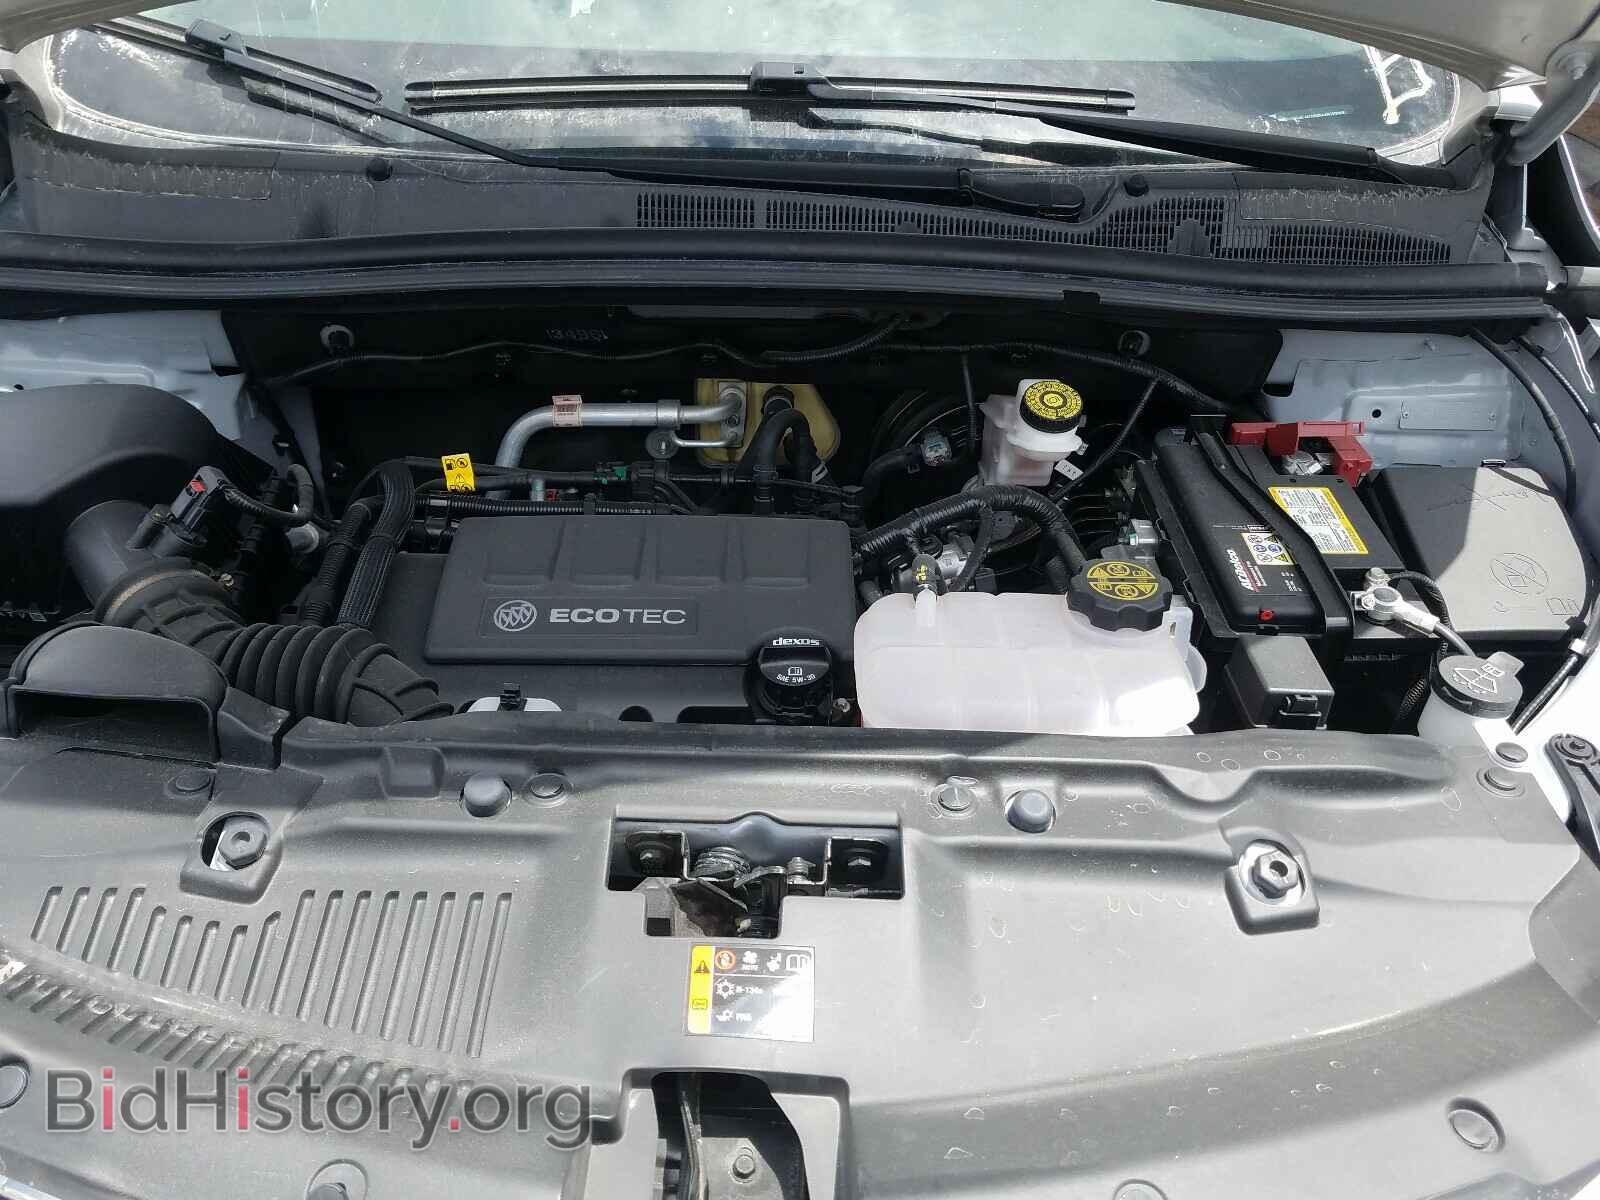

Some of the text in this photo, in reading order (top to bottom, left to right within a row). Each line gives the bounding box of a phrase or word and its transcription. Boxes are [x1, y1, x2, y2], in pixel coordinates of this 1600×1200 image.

[549, 608, 687, 624] ECOTEC
[772, 637, 820, 646] dexos
[776, 673, 816, 683] SAE 5W-30
